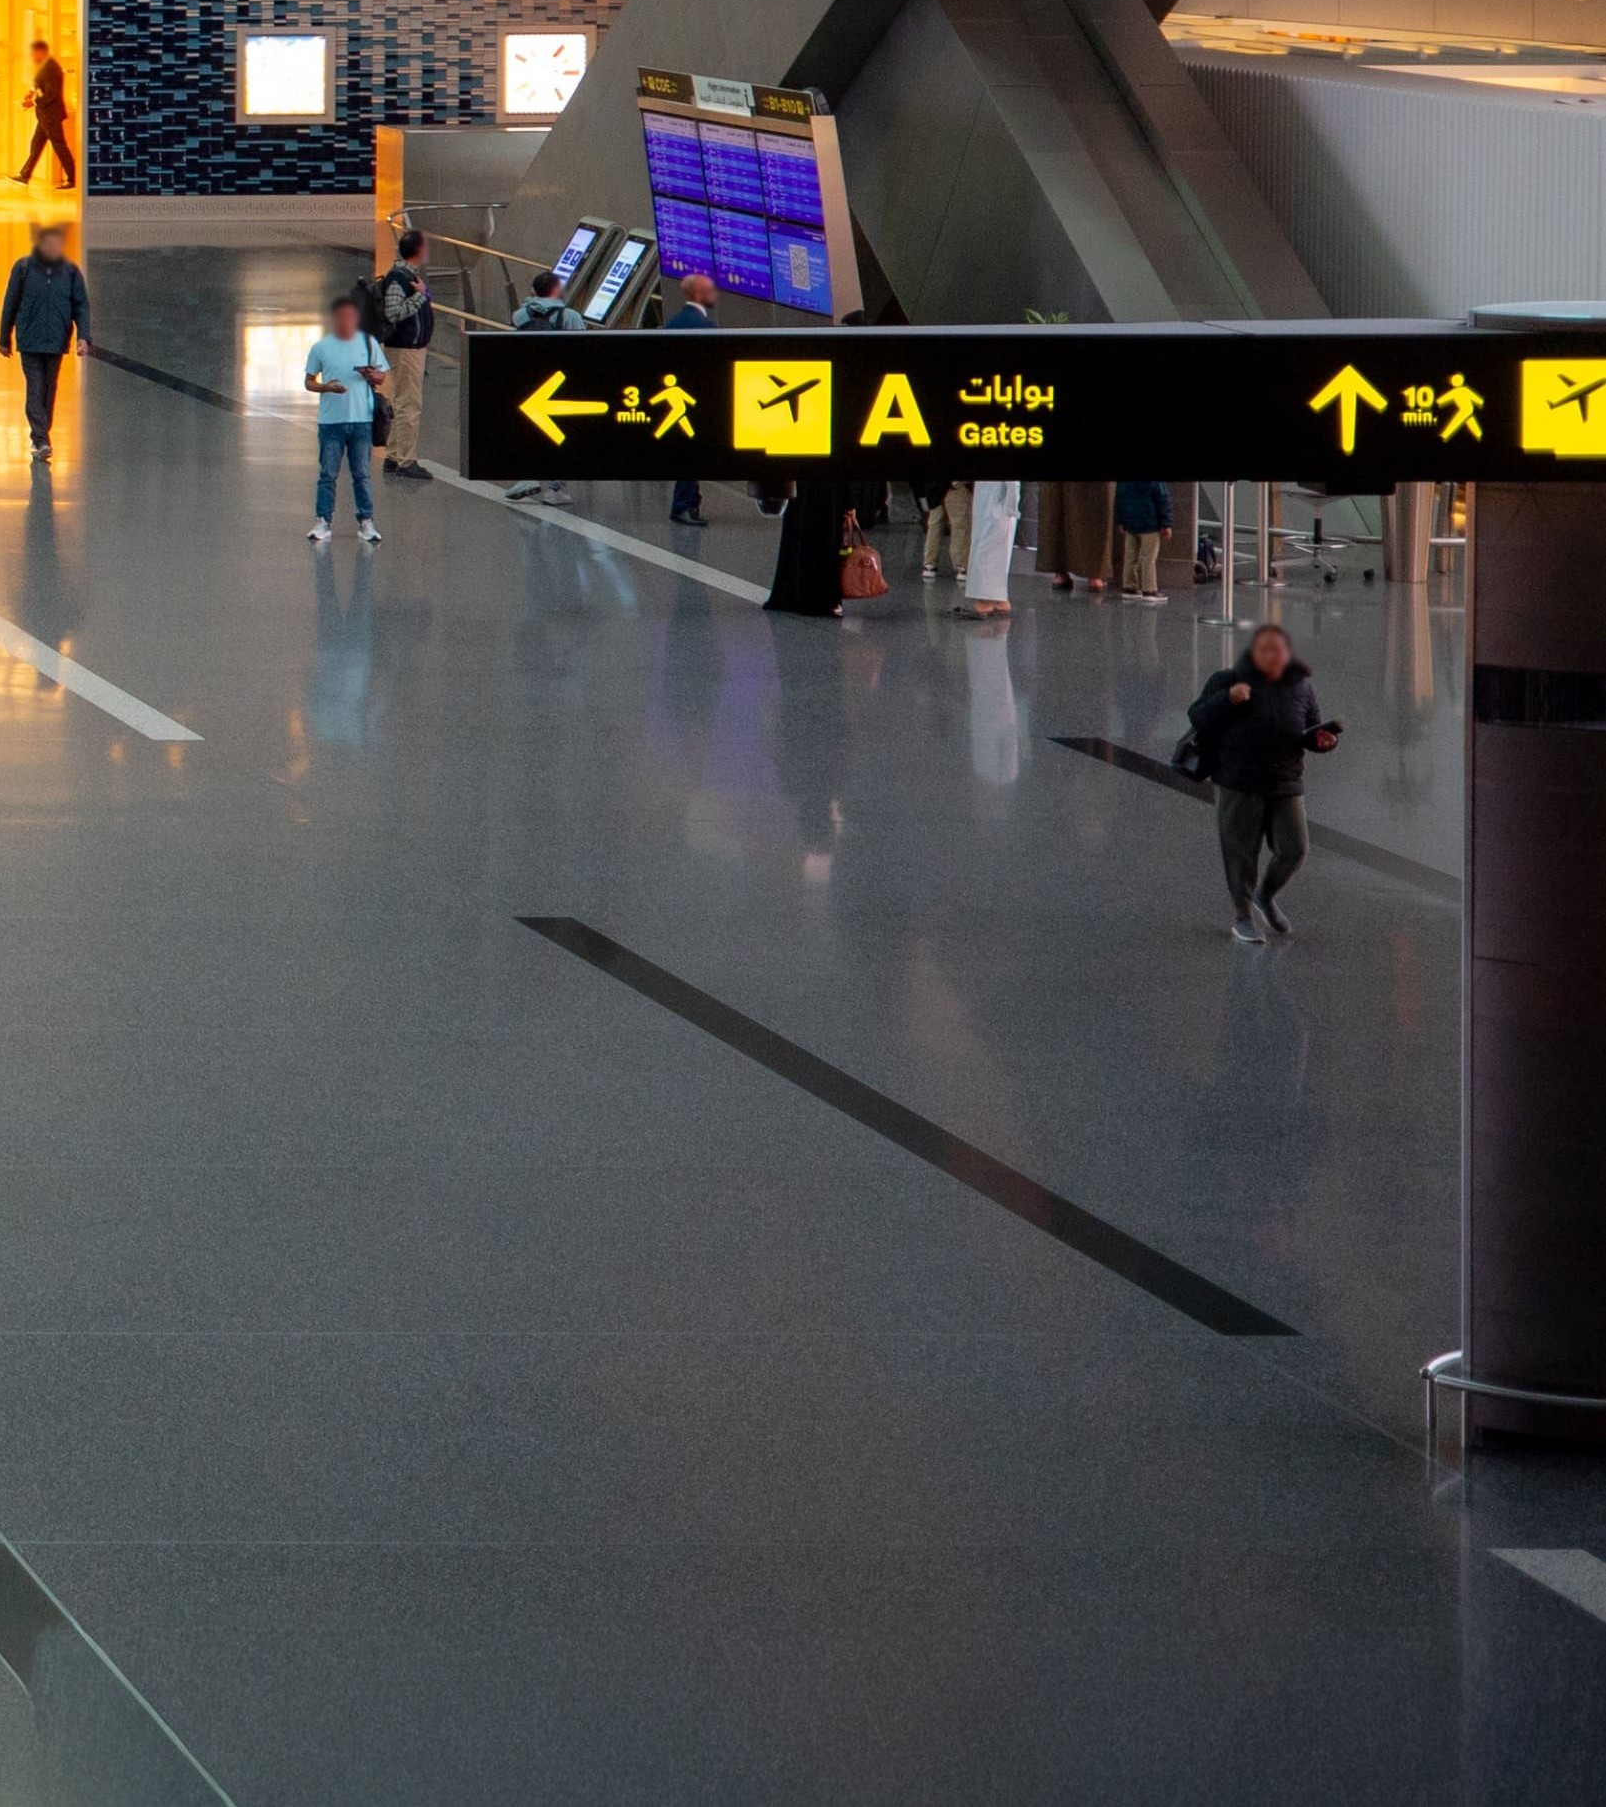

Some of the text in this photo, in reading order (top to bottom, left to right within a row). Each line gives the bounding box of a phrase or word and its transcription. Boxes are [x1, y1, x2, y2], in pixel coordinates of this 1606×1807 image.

[622, 386, 640, 407] 3
[959, 374, 1055, 411] بوابات
[1401, 385, 1435, 409] 10
[616, 407, 652, 424] min.
[859, 373, 932, 446] A
[1401, 409, 1438, 427] min.
[959, 422, 1045, 447] Gates
